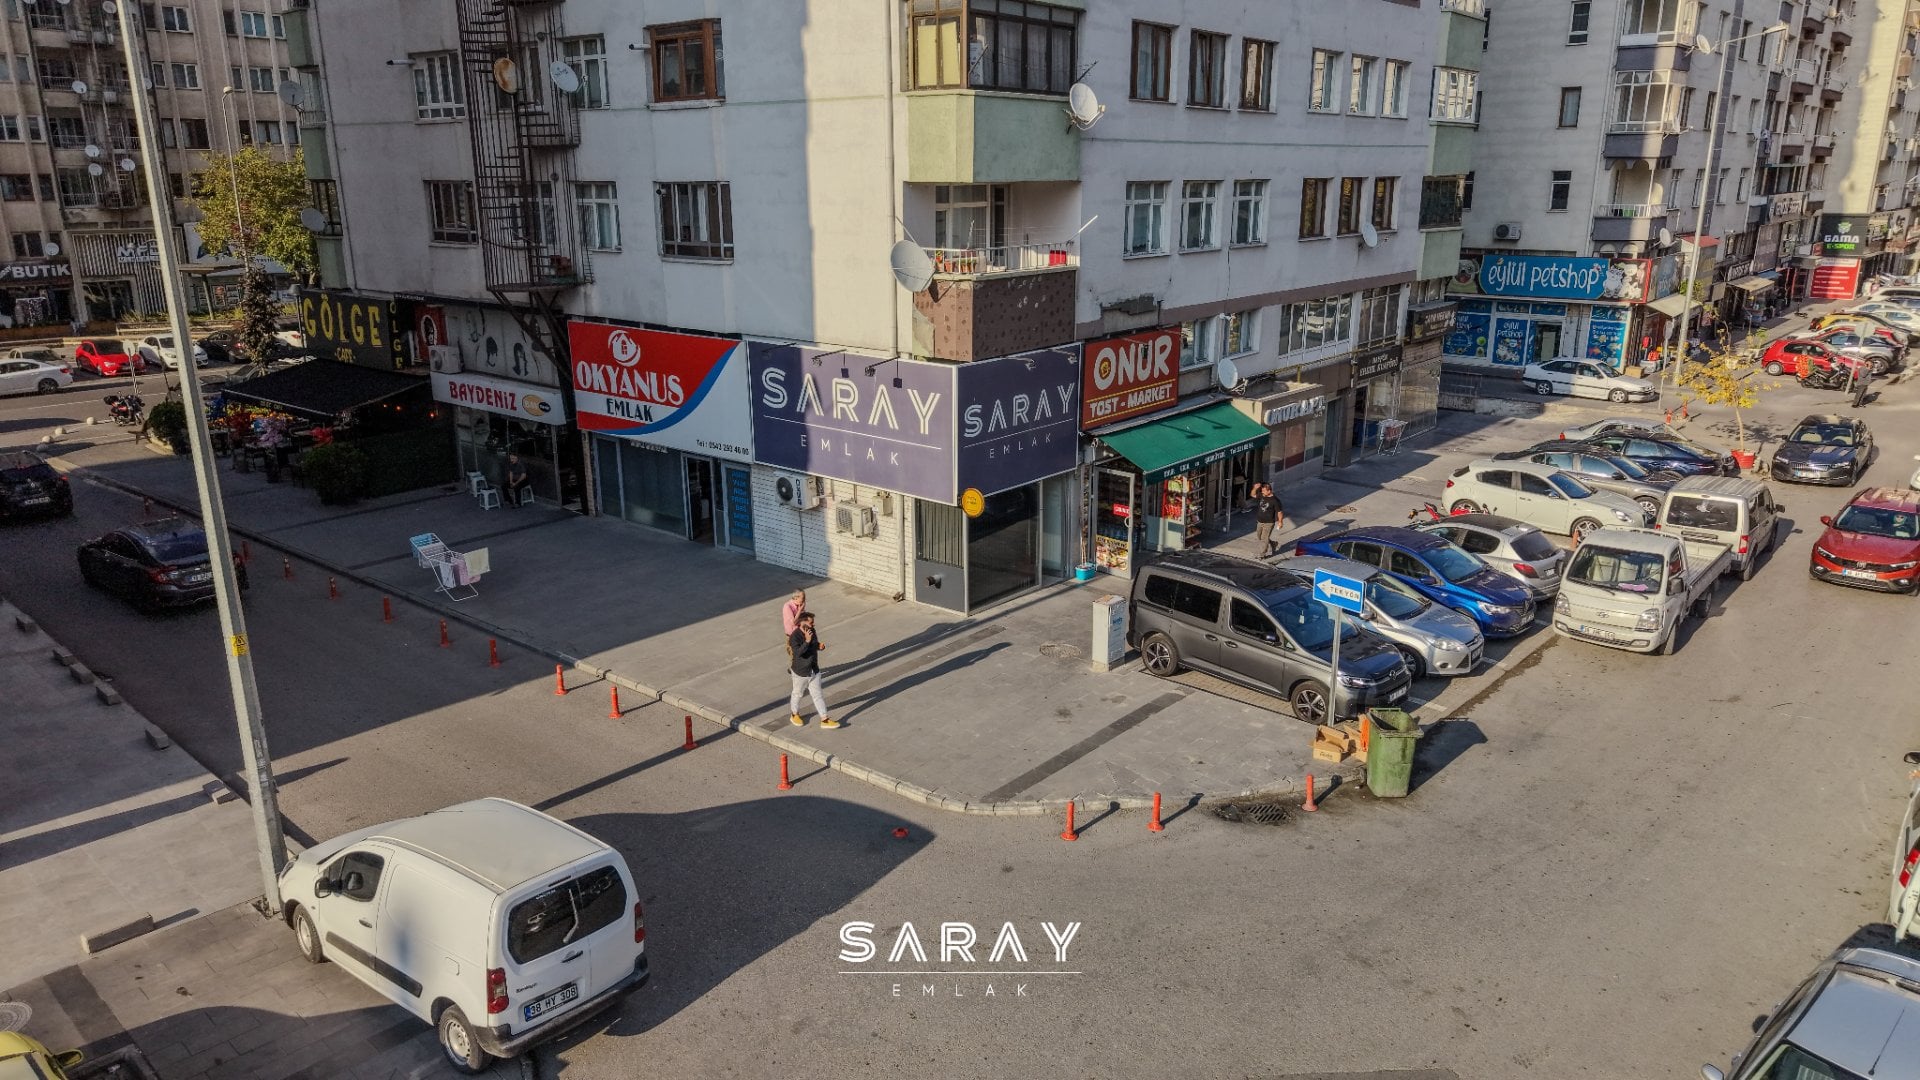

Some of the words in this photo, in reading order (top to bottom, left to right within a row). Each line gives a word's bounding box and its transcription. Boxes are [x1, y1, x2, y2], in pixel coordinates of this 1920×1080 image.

[1824, 235, 1859, 243] GAMA
[1488, 261, 1525, 292] eylül
[1530, 263, 1600, 294] petshop
[303, 293, 383, 348] GÖLGE
[1093, 335, 1173, 391] ONUR
[576, 360, 684, 406] OKYANUS
[606, 397, 653, 422] EMLAK
[762, 366, 941, 435] SARAY
[963, 382, 1075, 438] SARAY
[1090, 396, 1117, 418] TOST
[1127, 384, 1173, 409] MARKET
[800, 434, 899, 466] EMLAK
[989, 432, 1052, 459] EMLAK
[531, 1004, 542, 1015] 38
[545, 996, 556, 1008] HY
